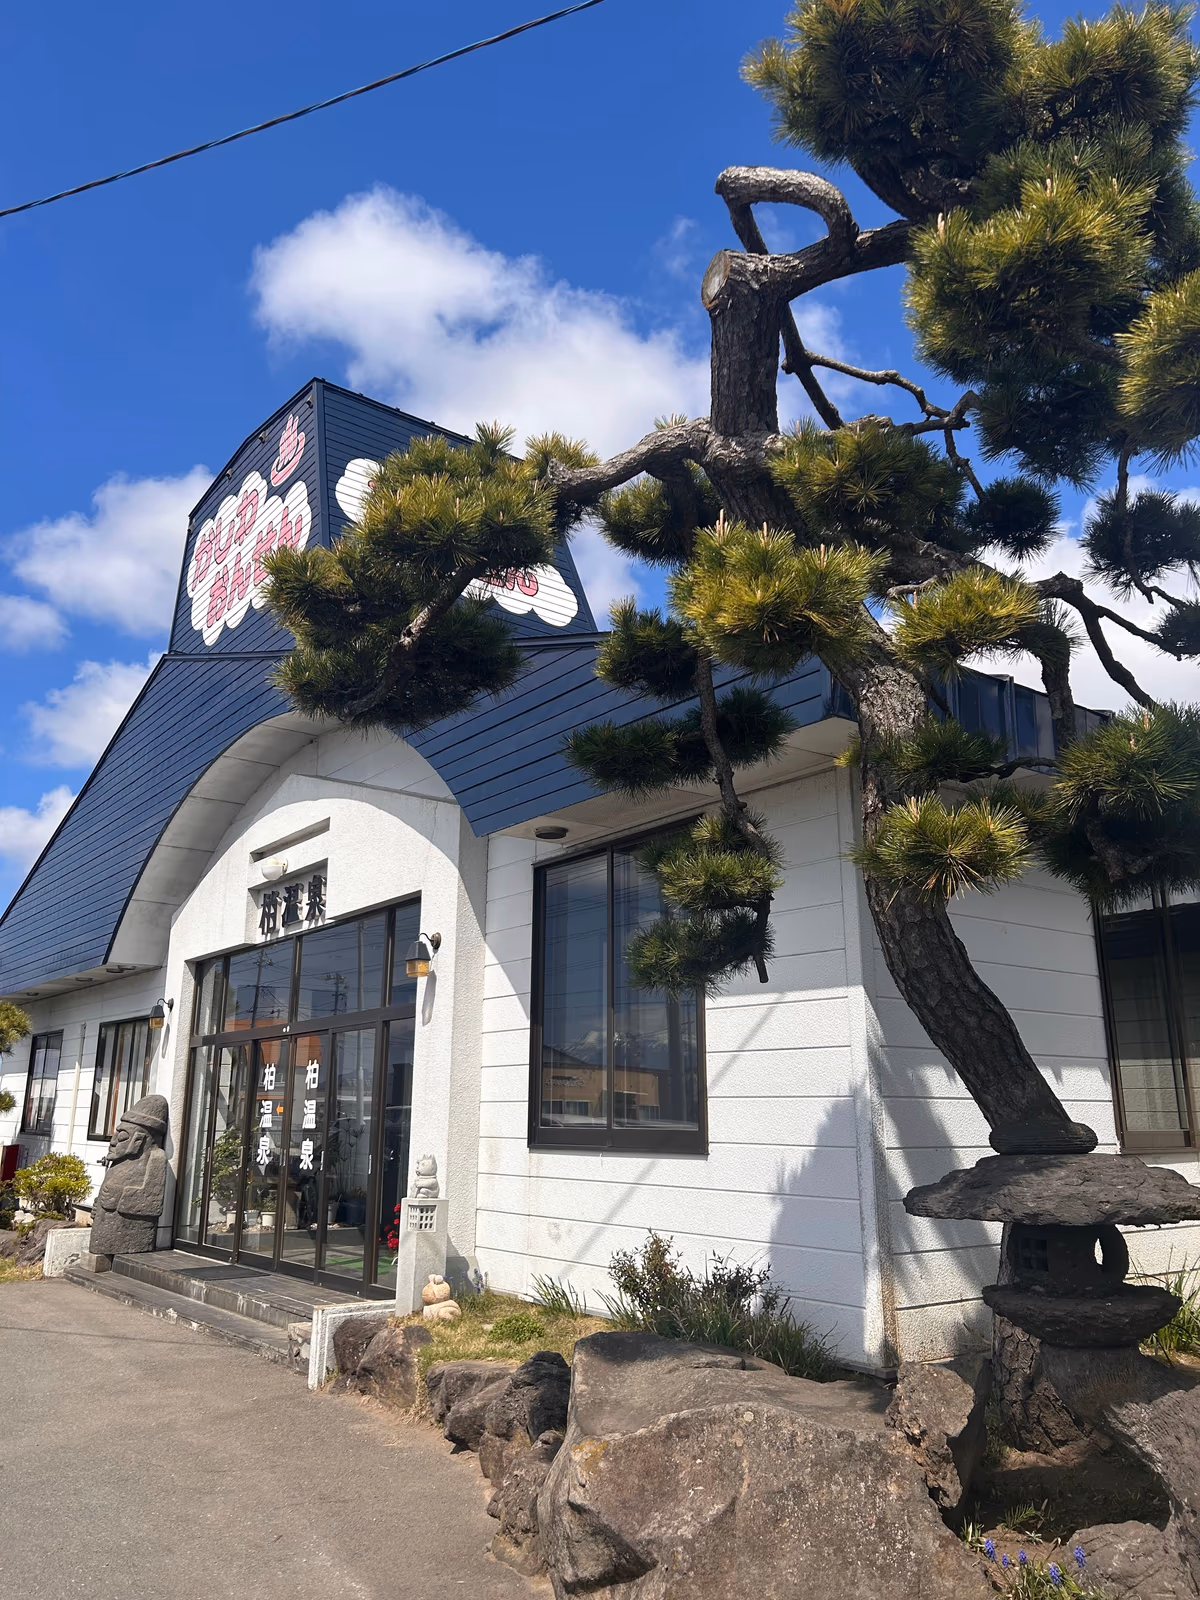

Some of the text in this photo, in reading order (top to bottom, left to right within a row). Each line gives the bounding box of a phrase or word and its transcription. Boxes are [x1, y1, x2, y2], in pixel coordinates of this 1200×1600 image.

[256, 1063, 276, 1165] 柏温泉
[299, 1059, 319, 1170] 柏温泉
